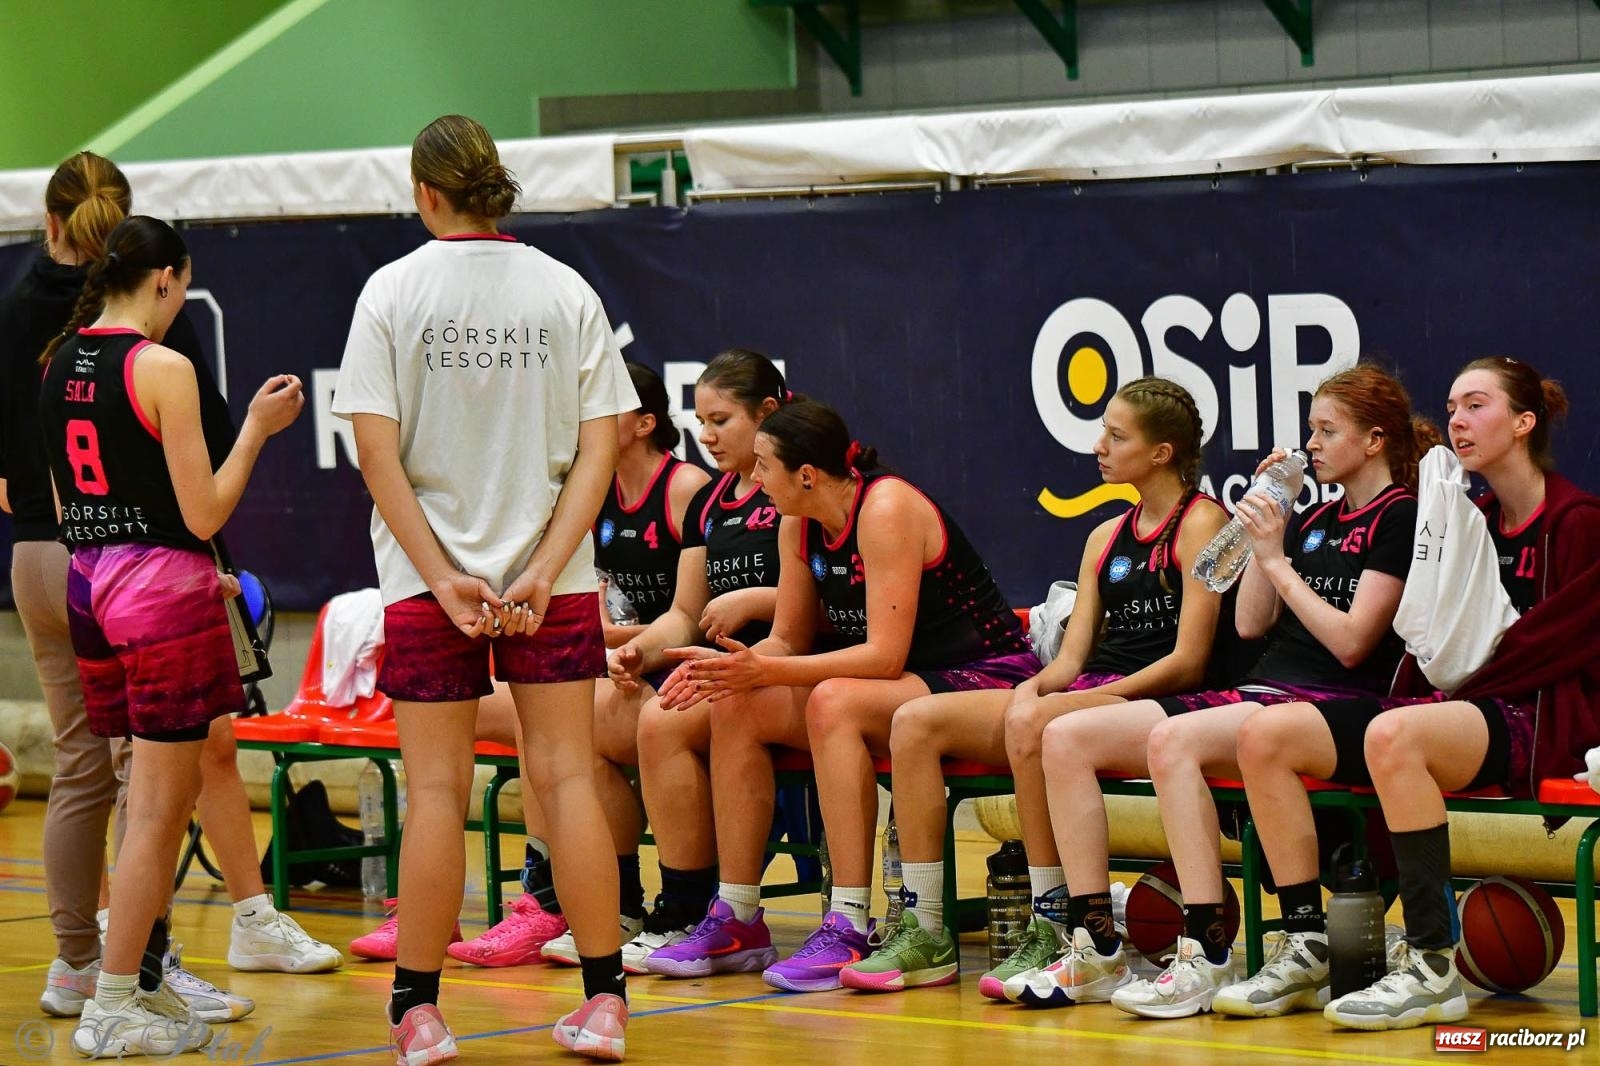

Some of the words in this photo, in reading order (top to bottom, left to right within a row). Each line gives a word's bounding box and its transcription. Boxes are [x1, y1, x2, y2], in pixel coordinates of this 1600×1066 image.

[65, 380, 95, 402] SALA
[66, 419, 110, 495] 8
[746, 506, 777, 530] 42
[644, 521, 658, 549] 4
[1341, 527, 1366, 553] 15
